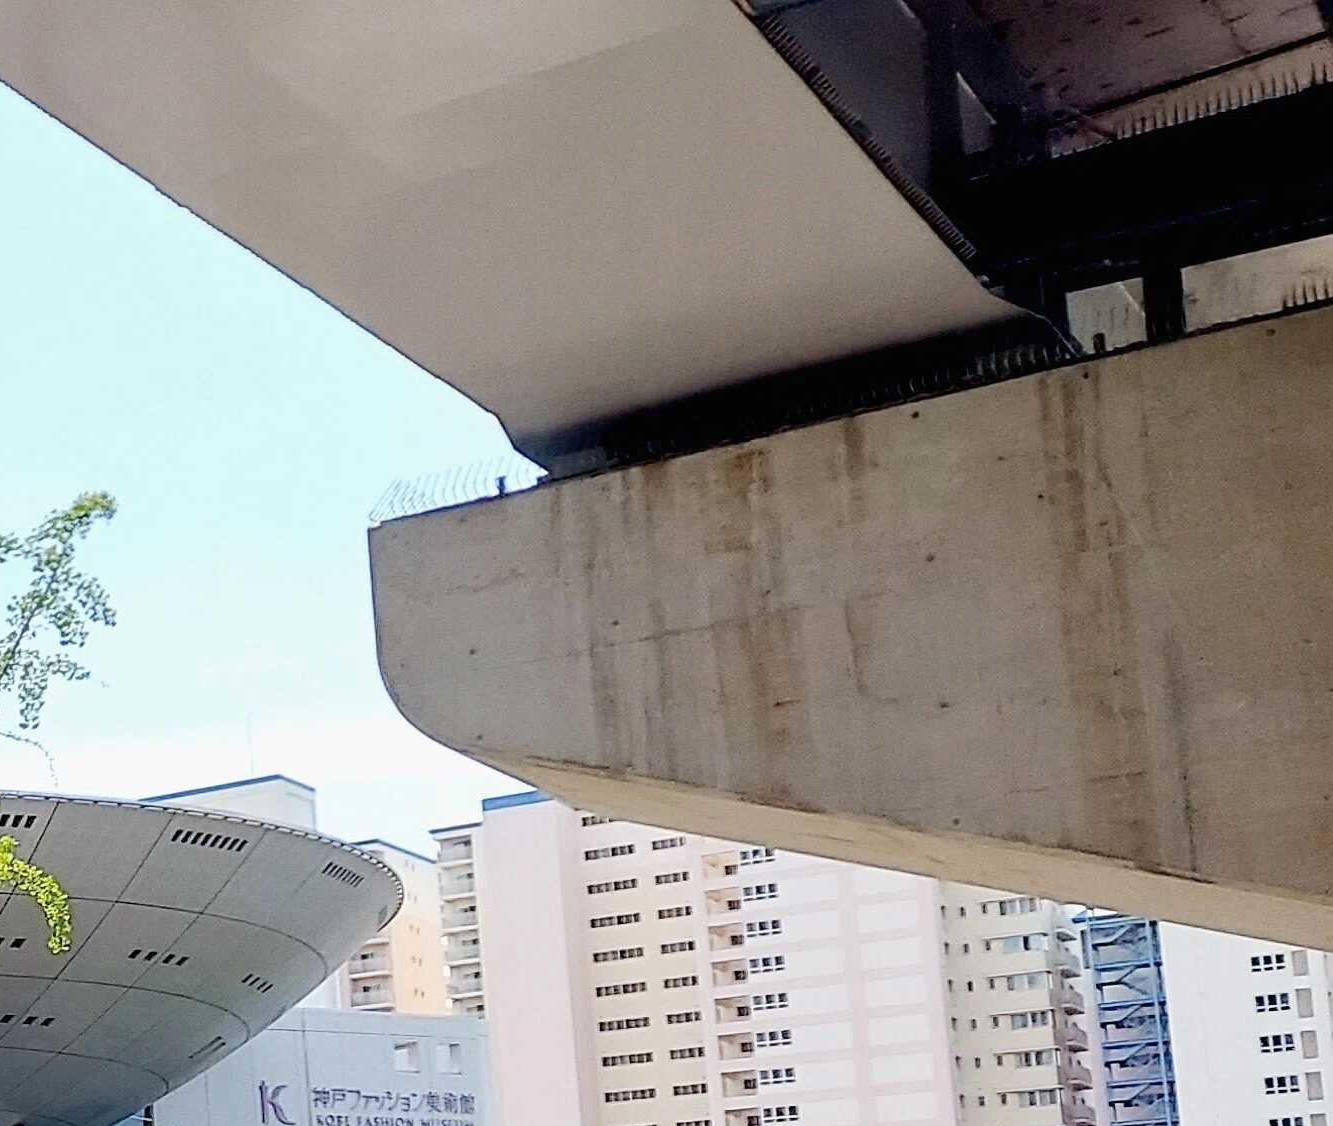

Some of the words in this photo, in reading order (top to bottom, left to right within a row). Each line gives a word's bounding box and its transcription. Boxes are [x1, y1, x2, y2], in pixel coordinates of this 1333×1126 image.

[312, 1087, 475, 1114] 神戸ファッション美術館
[316, 1114, 350, 1126] KOBE
